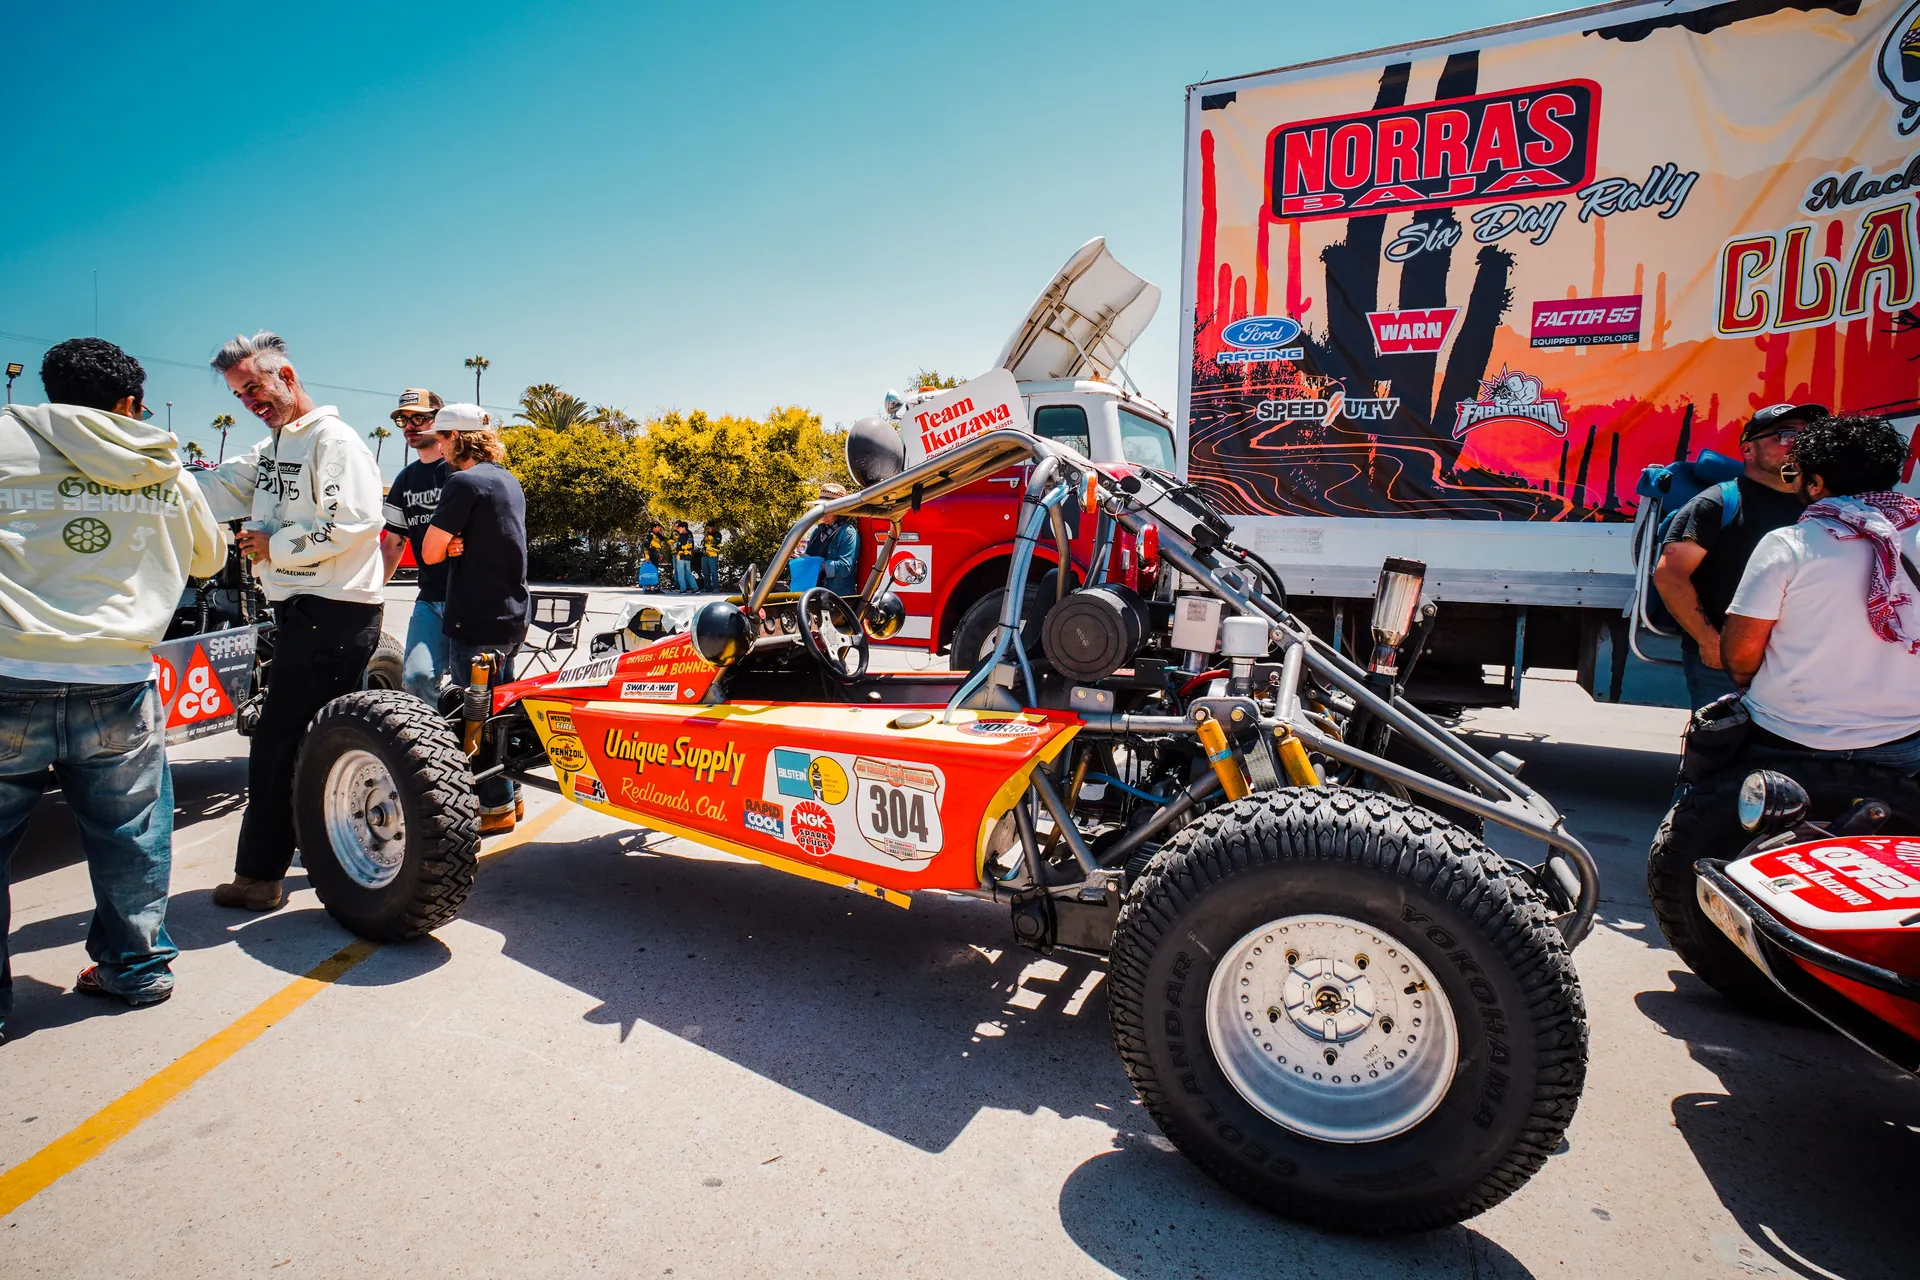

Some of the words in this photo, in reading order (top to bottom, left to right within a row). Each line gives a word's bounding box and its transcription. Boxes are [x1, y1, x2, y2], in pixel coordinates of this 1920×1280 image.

[1282, 93, 1576, 195] NORRA'S
[1282, 169, 1570, 214] BAJA
[1385, 219, 1461, 261] Six
[1472, 202, 1566, 245] Day
[1577, 162, 1699, 222] Rally
[1535, 308, 1605, 328] FACTOR
[1607, 307, 1637, 323] 55
[1239, 323, 1284, 342] Ford
[1380, 322, 1442, 341] WARN
[1532, 337, 1577, 346] EQUIPPED
[1218, 349, 1303, 362] RACING
[914, 397, 974, 433] Team
[1258, 401, 1328, 420] SPEED
[1343, 399, 1399, 419] UTV
[920, 404, 1011, 454] Ikuzawa
[141, 483, 180, 506] Art
[210, 633, 255, 655] SAFARI
[210, 649, 255, 661] SPECIAL
[626, 653, 656, 665] DRIVERS:
[659, 646, 680, 660] MEL
[647, 663, 668, 676] JIM
[550, 747, 584, 759] PENNZOIL
[604, 728, 668, 774] Unique
[670, 736, 746, 787] Supply
[778, 767, 808, 781] BILSTEIN
[696, 796, 728, 823] Cal.
[745, 799, 780, 818] RAPID
[870, 784, 929, 843] 304
[747, 812, 781, 832] COOL
[797, 812, 827, 829] NGK
[800, 829, 828, 840] SPARK
[800, 837, 828, 848] PLUGS
[1403, 904, 1511, 1131] YOKOHAMA
[1163, 950, 1301, 1178] GEOLANDAR
